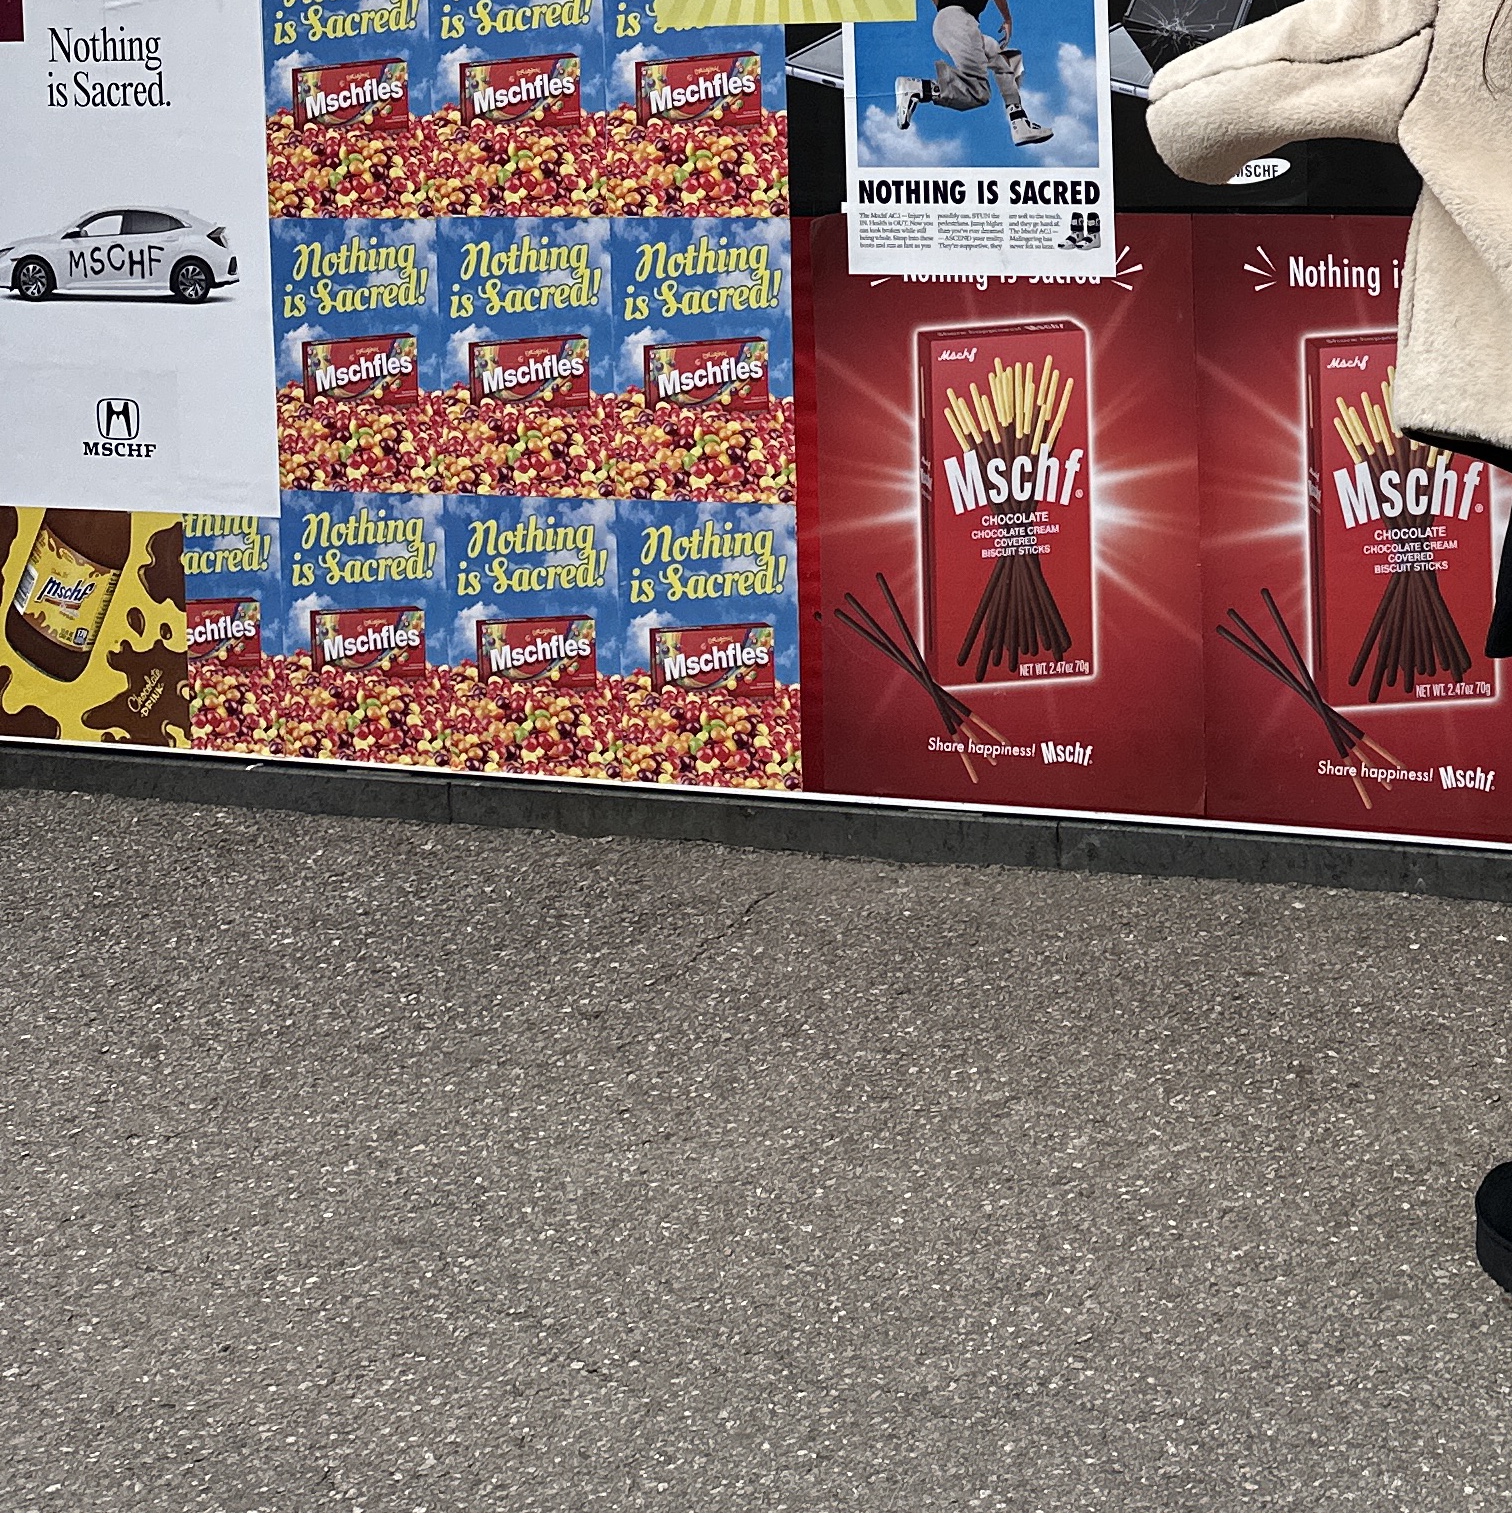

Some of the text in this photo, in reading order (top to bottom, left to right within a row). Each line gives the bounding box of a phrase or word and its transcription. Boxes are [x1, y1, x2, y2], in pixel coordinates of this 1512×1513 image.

[273, 9, 296, 46] is
[440, 4, 465, 41] is
[47, 26, 162, 71] Nothing
[47, 70, 172, 108] is Sacred.
[305, 74, 404, 122] Mschfles
[473, 72, 576, 120] Mschfles
[649, 71, 757, 116] Mschfles
[858, 179, 1101, 205] NOTHING IS SACRED
[69, 243, 165, 280] MSCHF
[292, 235, 416, 281] Nothing
[633, 236, 770, 283] Nothing
[1289, 254, 1380, 296] Nothing
[283, 268, 430, 320] is Sacred!
[623, 271, 780, 322] is Sacred!
[315, 352, 413, 393] Mschfles
[938, 347, 978, 362] Mschf
[1326, 355, 1370, 370] Mschf
[657, 355, 764, 399] Mschfles
[83, 441, 157, 458] MSCHF
[301, 509, 423, 557] Nothing
[971, 524, 1060, 539] CHOCOLATE CREAM
[981, 511, 1049, 526] CHOCOLATE
[1374, 526, 1447, 541] CHOCOLATE
[981, 544, 1051, 558] BISCUIT STICKS
[994, 536, 1037, 548] COVERED
[1363, 540, 1458, 555] CHOCOLATE CREAM
[1388, 551, 1434, 563] COVERED
[291, 540, 437, 588] is Sacred!
[1374, 560, 1449, 574] BISCUIT STICKS
[186, 616, 256, 647] schfles
[323, 626, 421, 664] Mschfles
[1019, 664, 1033, 677] NET
[1075, 660, 1090, 674] 70g
[1415, 684, 1430, 698] NET
[1475, 681, 1491, 696] 70g
[928, 737, 965, 752] Share
[968, 738, 1036, 758] happiness!
[1317, 760, 1357, 777] Share
[1361, 761, 1434, 783] happiness!
